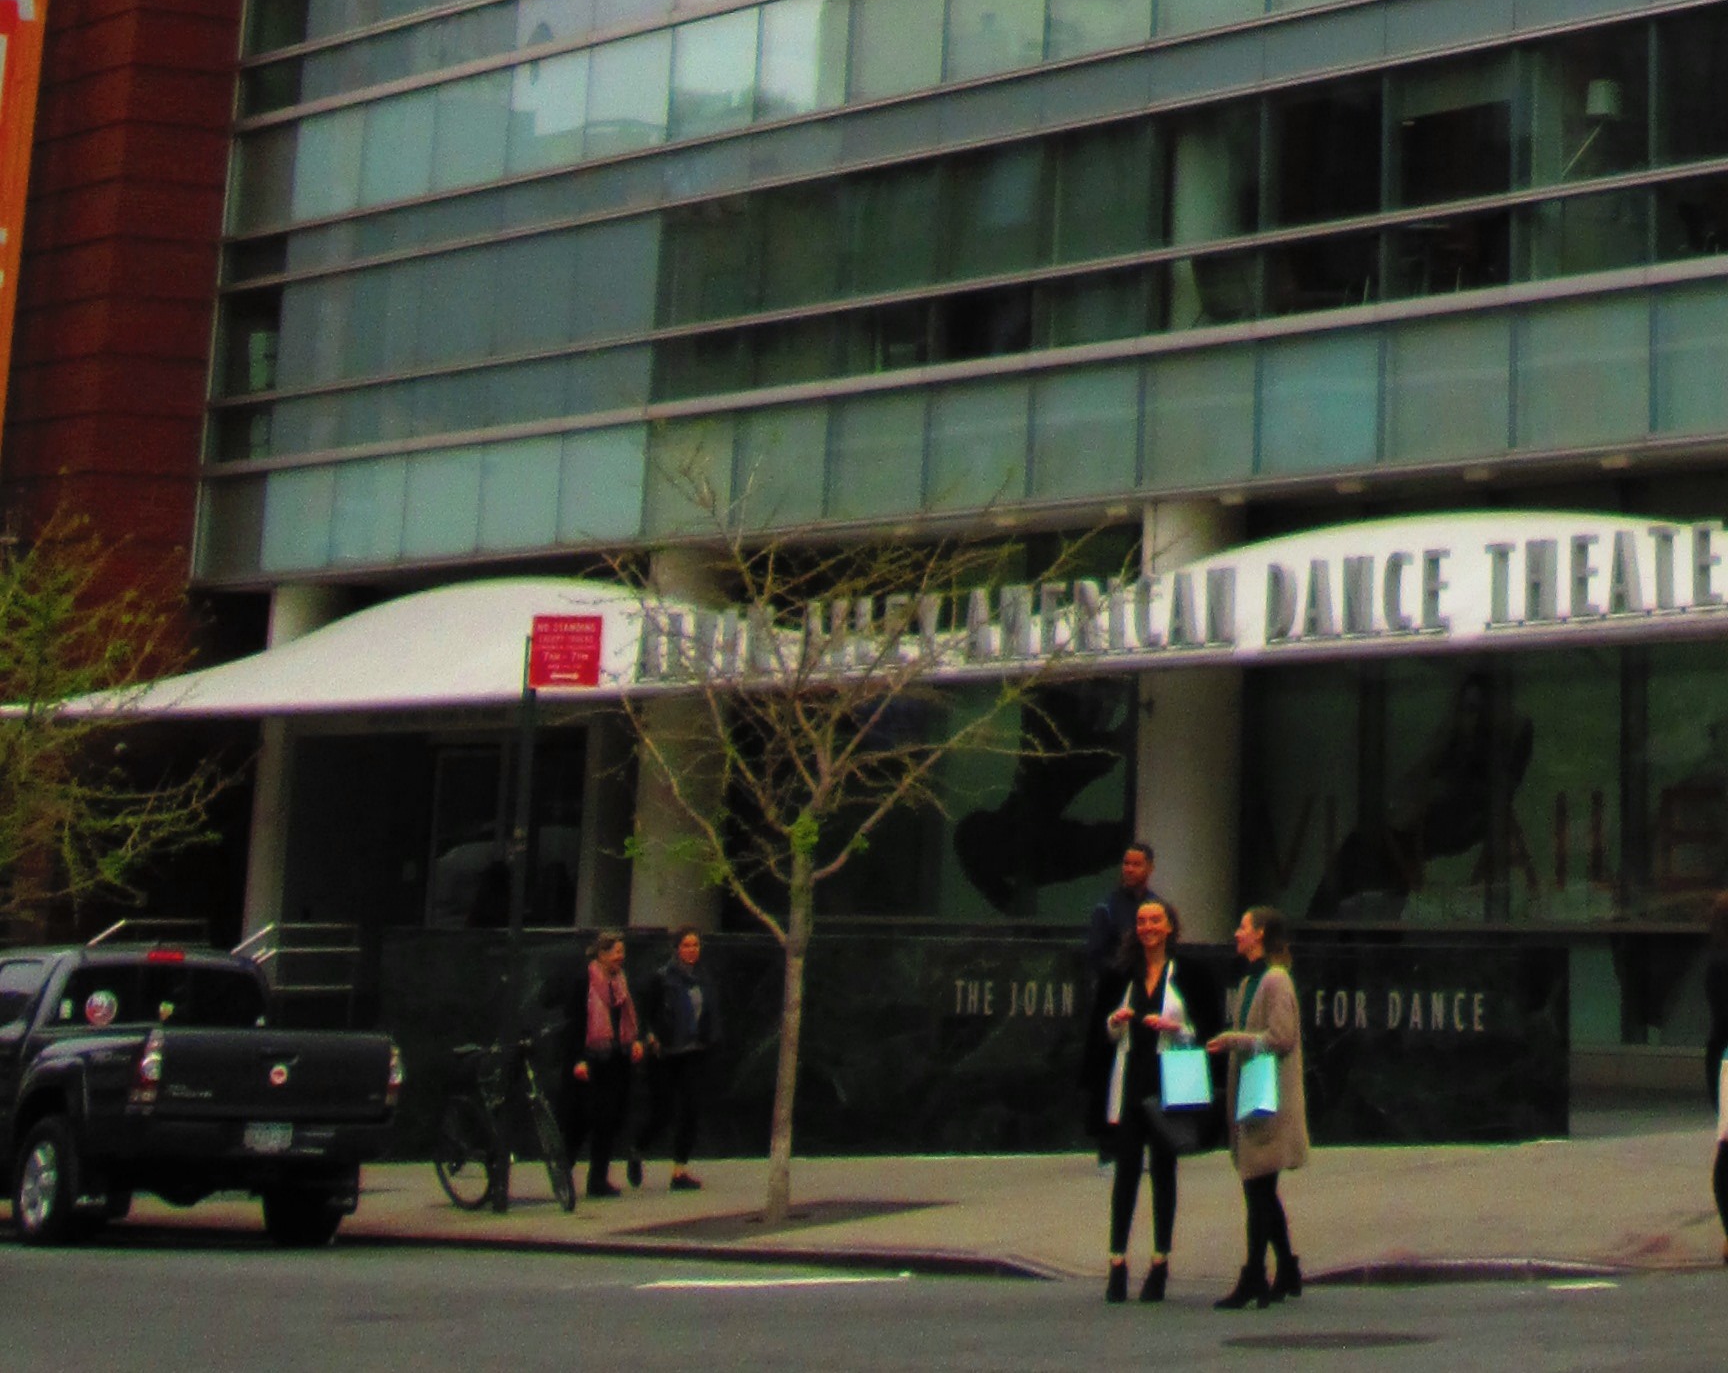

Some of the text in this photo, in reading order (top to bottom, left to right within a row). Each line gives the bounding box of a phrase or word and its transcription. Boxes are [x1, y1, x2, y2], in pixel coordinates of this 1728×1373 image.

[966, 566, 1238, 663] AMERICAN
[1265, 548, 1451, 644] DANCE
[954, 979, 1485, 1033] THE JOAN FOR DANCE
